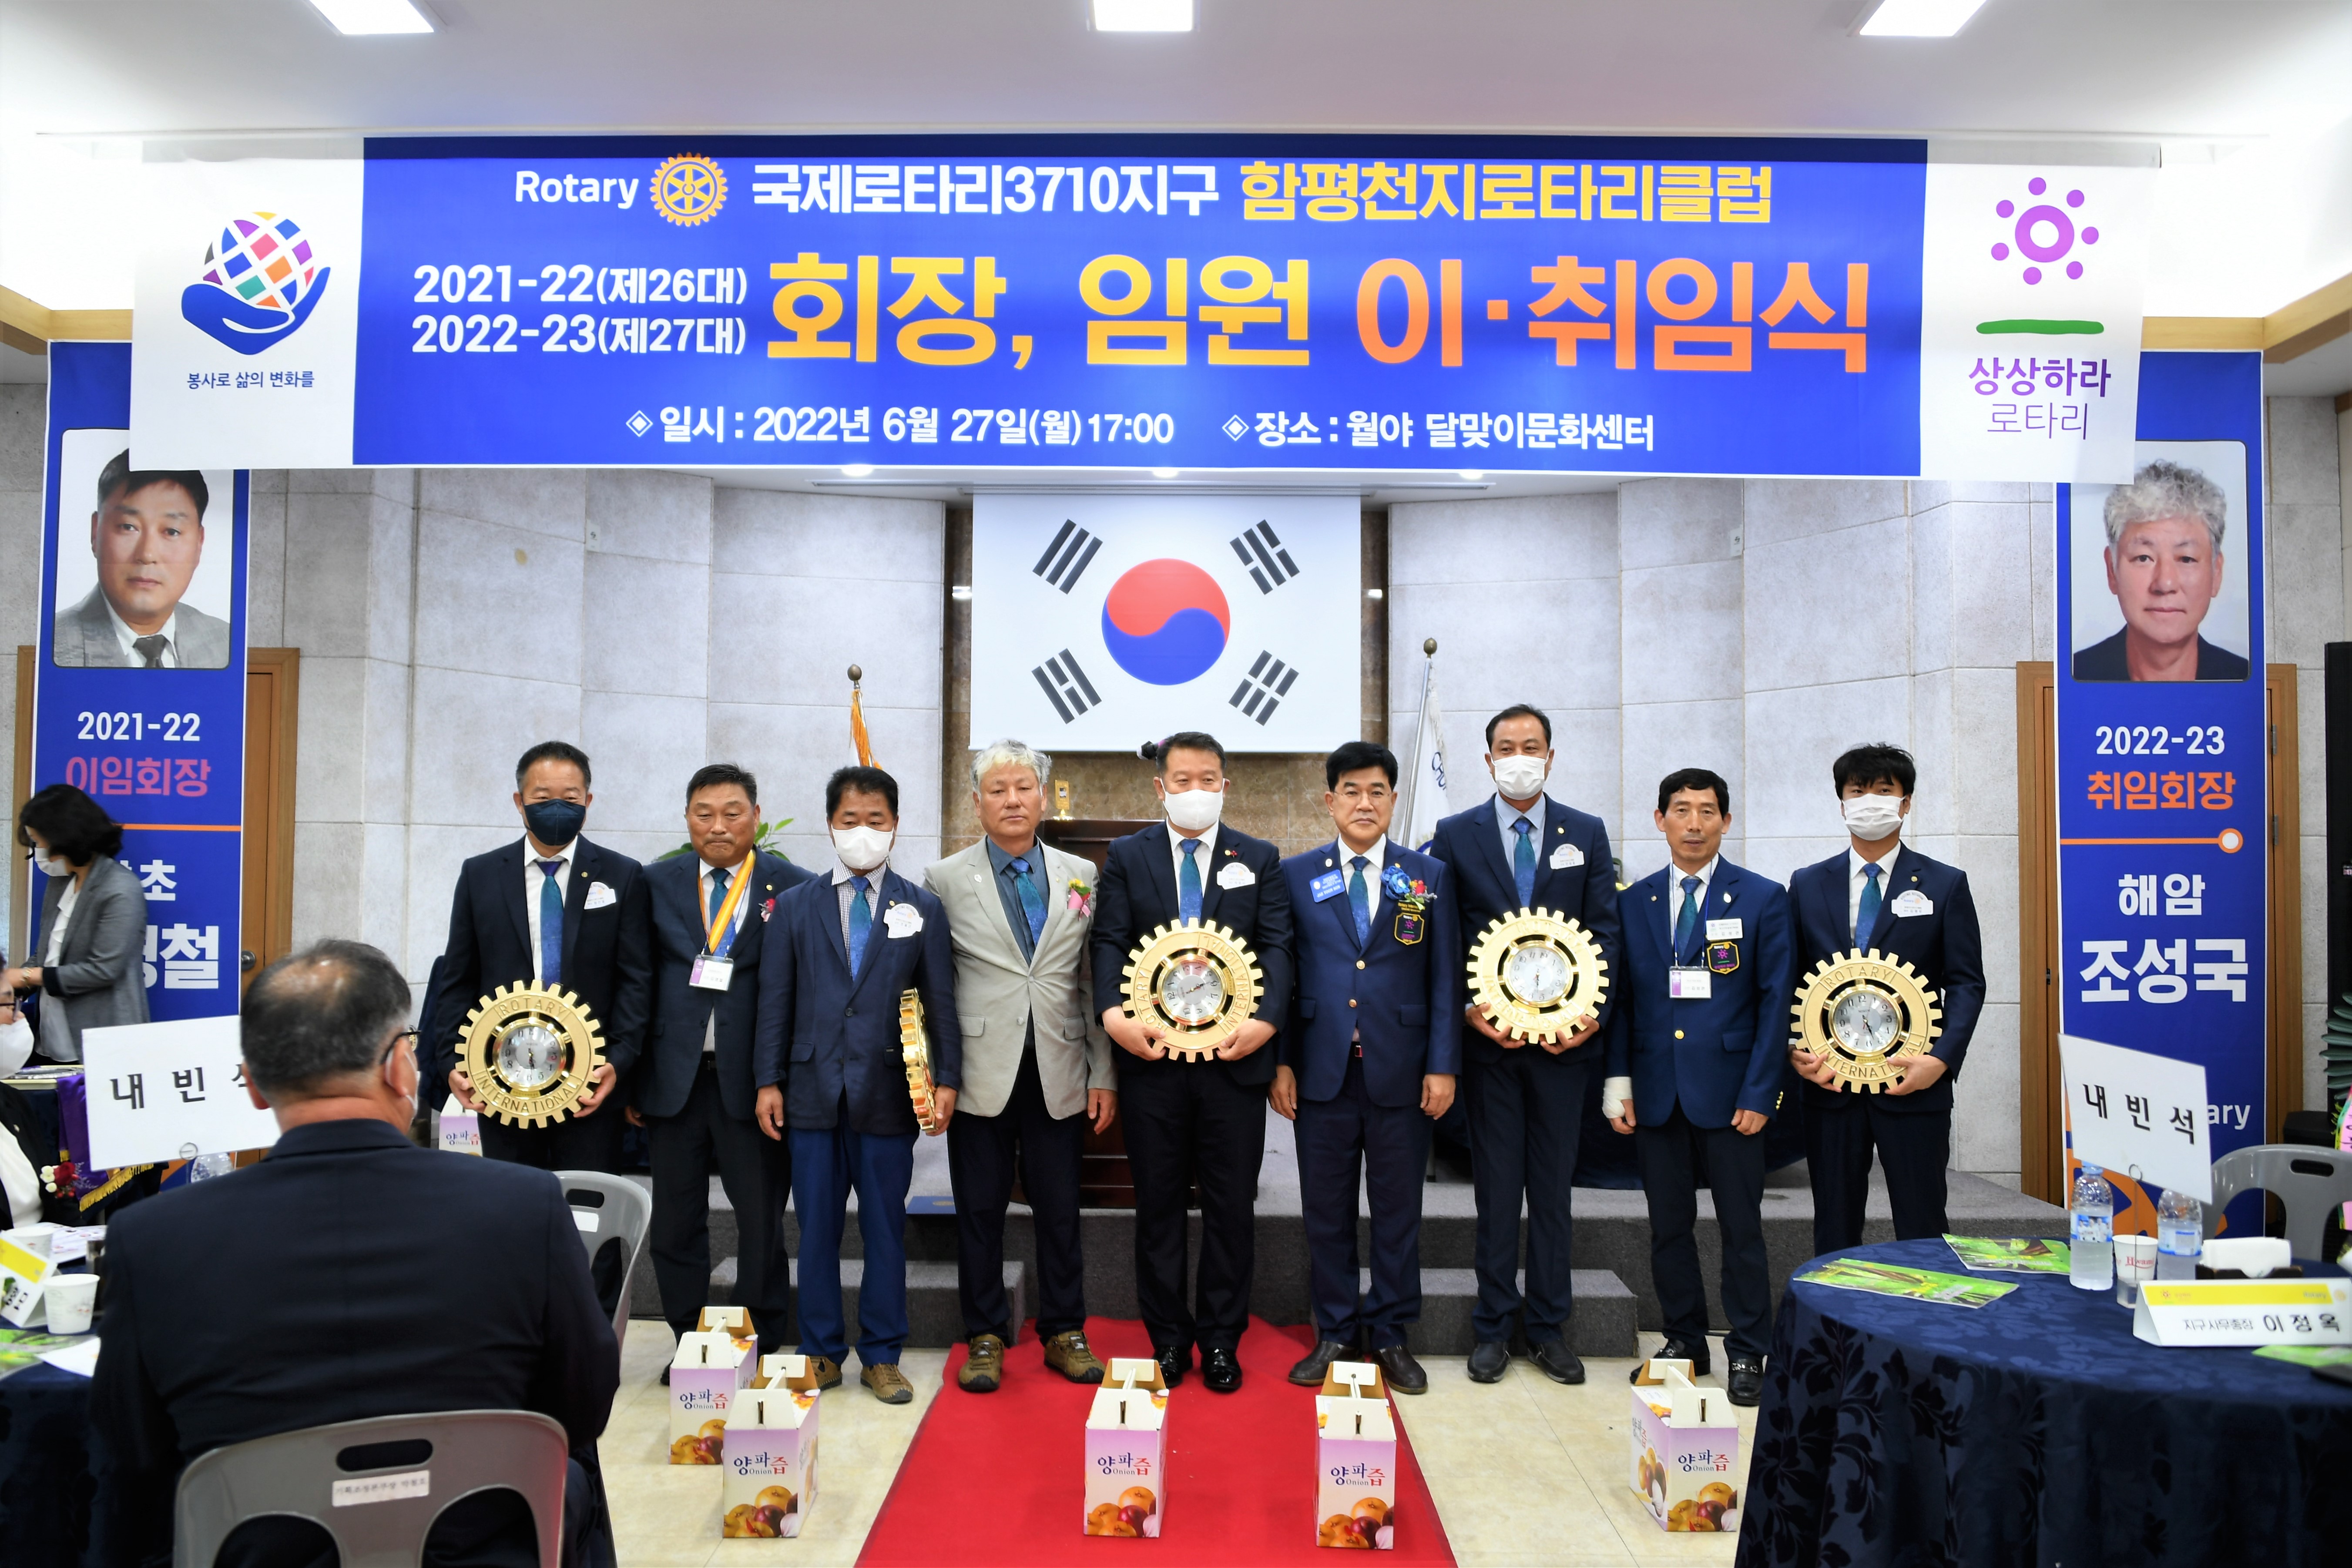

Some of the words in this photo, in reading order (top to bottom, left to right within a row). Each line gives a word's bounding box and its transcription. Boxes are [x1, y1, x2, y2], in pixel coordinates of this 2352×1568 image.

[516, 171, 640, 210] Rotary
[752, 165, 1220, 216] 국제로타리3710지구
[1241, 161, 1772, 224] 함평천지로타리클럽
[414, 265, 748, 305] 2021-22(제26대)
[767, 252, 1033, 371] 회장,
[1079, 254, 1310, 366] 임원
[413, 314, 746, 355] 2022-23(제27대)
[187, 373, 231, 390] 봉사로
[236, 372, 264, 389] 삶의
[270, 371, 315, 388] 변화를
[1969, 357, 2113, 398] 상상하라
[753, 407, 870, 443] 2022년
[883, 406, 939, 443] 6월
[1347, 410, 1414, 448] 월야
[1426, 412, 1654, 452] 달맞이문화센터
[1987, 403, 2088, 441] 로타리
[78, 712, 201, 742] 2021-22
[2096, 726, 2225, 755] 2022-23
[67, 757, 211, 797] 이임회장
[2088, 771, 2237, 810] 취임회장
[2118, 873, 2206, 916] 해암
[1824, 966, 1892, 989] ROTARY
[2080, 939, 2249, 1004] 조성국
[500, 997, 567, 1015] ROTARY
[476, 1076, 583, 1113] INTERNATIONAL
[2207, 1104, 2251, 1130] ary
[680, 1389, 728, 1410] 양파즙
[734, 1452, 788, 1475] 양파즙
[1097, 1452, 1151, 1476] 양파즙
[1331, 1463, 1386, 1486] 양파즙
[1678, 1449, 1730, 1472] 양파즙
